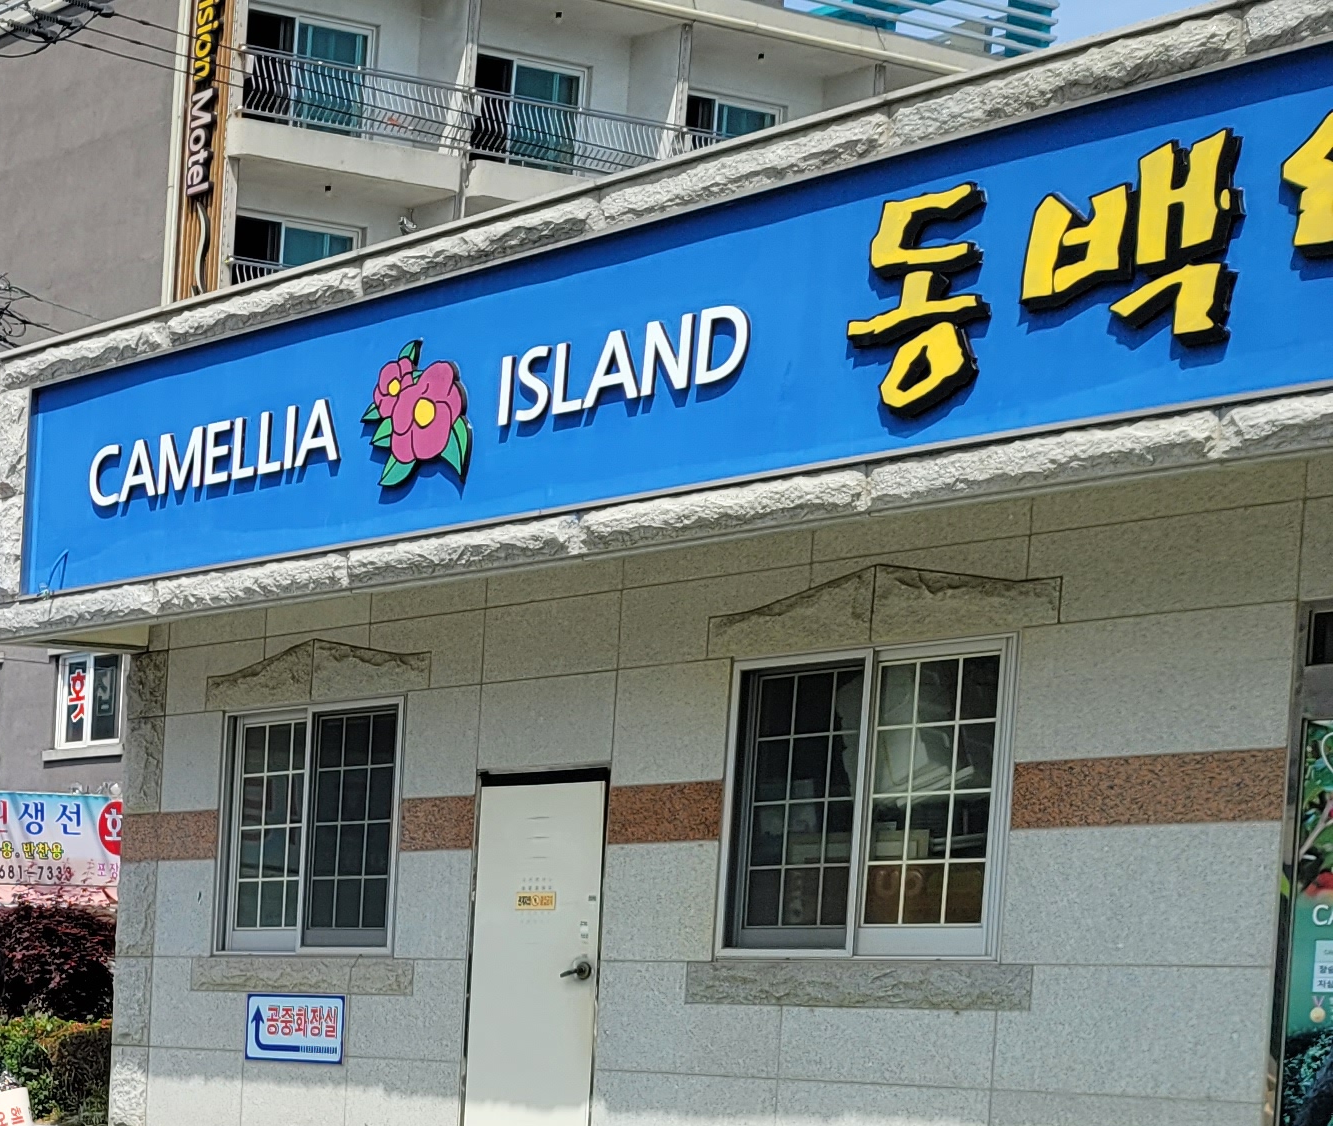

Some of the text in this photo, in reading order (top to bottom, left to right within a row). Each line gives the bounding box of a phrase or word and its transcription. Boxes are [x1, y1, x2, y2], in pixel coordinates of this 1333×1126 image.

[186, 88, 214, 197] Motel
[89, 305, 751, 506] CAMELLIA ISLAND
[266, 1004, 338, 1039] 공중화장실
